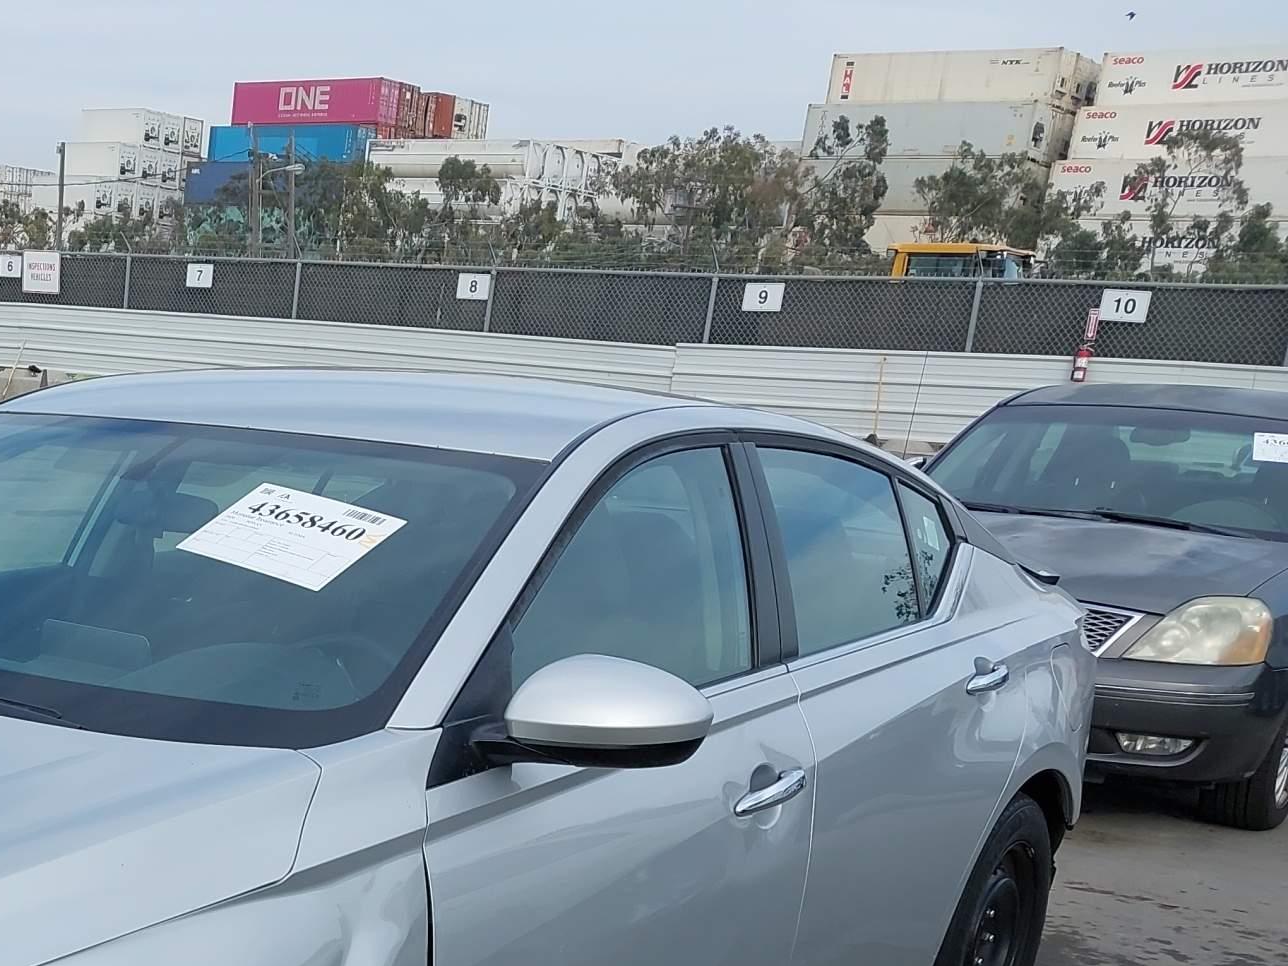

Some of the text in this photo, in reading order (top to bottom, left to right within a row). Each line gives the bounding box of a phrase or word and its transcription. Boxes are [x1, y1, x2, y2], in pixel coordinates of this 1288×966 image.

[1112, 56, 1145, 65] seaco
[1205, 59, 1288, 75] HORIZON
[1202, 74, 1275, 85] LINES
[278, 86, 330, 110] ONE
[1085, 111, 1117, 119] seaco
[1177, 117, 1262, 132] HORIZON
[1061, 165, 1092, 174] seaco
[1151, 175, 1235, 188] HORIZON
[196, 269, 204, 282] 7
[469, 279, 478, 293] 8
[757, 289, 769, 304] 9
[1113, 297, 1137, 314] 10
[247, 501, 367, 541] 43658460
